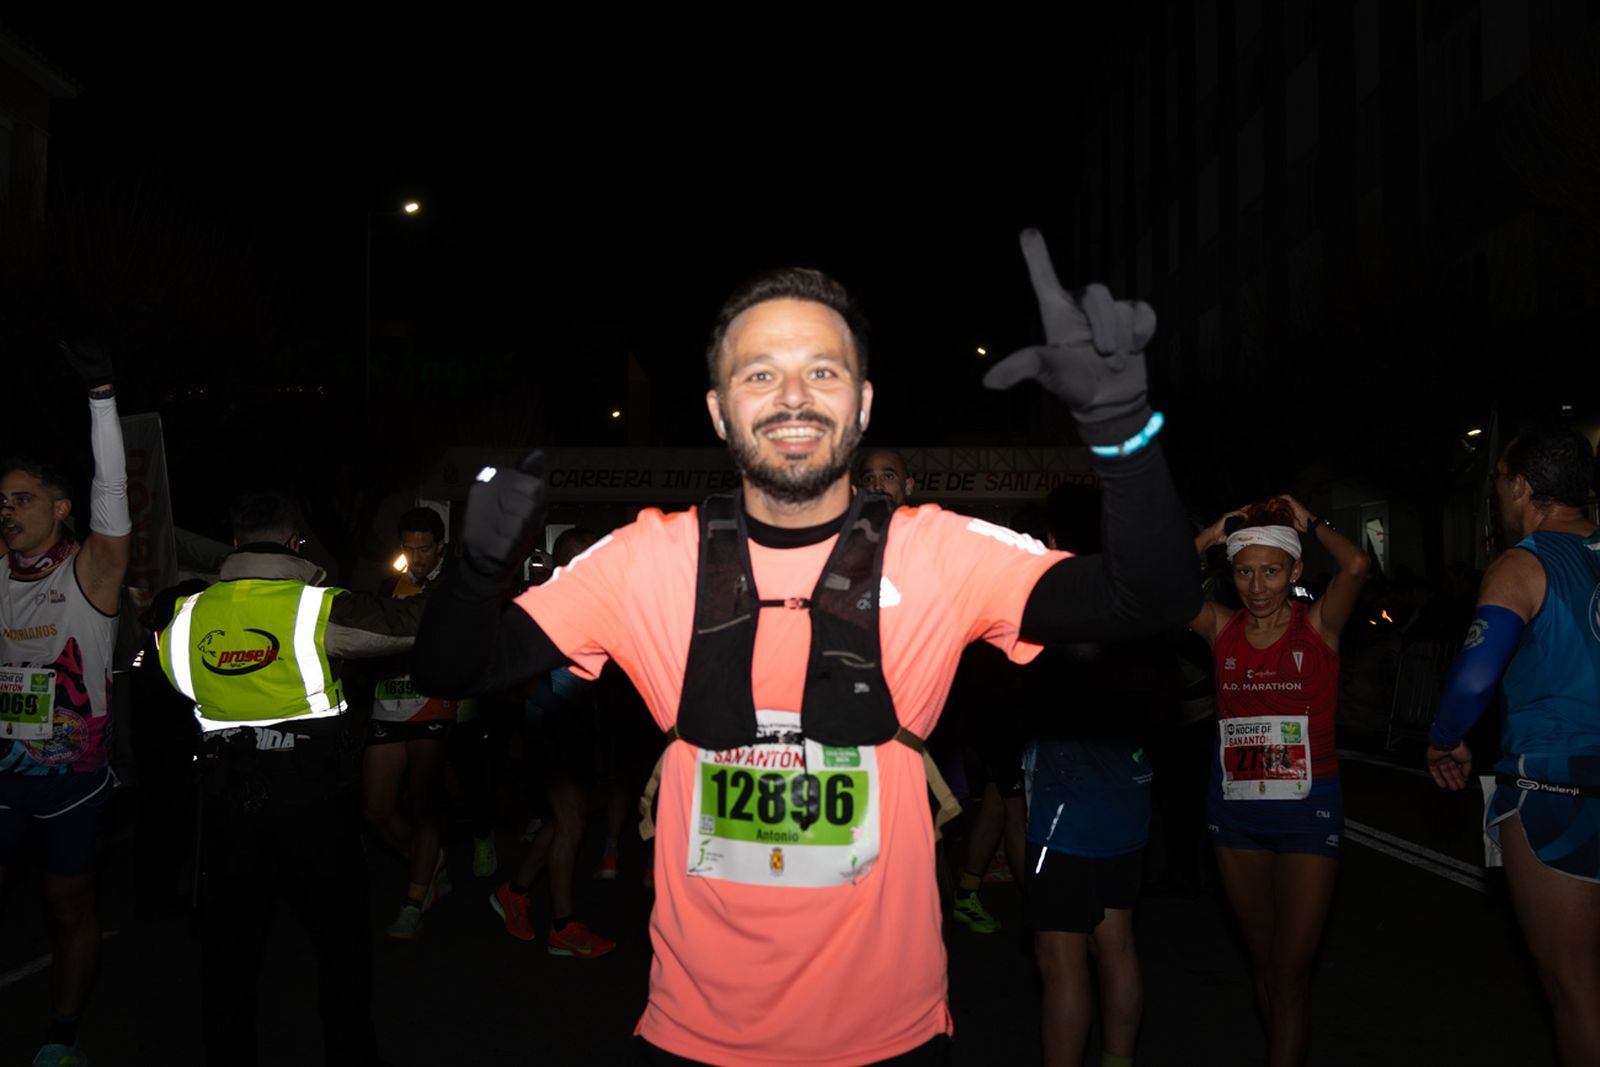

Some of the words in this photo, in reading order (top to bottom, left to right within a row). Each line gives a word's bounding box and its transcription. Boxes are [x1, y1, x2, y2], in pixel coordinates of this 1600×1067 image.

[549, 469, 652, 489] CARRERA
[661, 469, 744, 489] INTER
[945, 472, 977, 491] DE
[984, 472, 1031, 491] SAN
[1222, 682, 1239, 691] A.D.
[1242, 682, 1302, 692] MARATHON
[1235, 725, 1260, 735] NOCHE
[1229, 736, 1243, 746] SAN
[744, 746, 806, 769] ANTÓN
[1541, 784, 1580, 795] Kalenji
[711, 769, 856, 826] 12896
[756, 828, 800, 843] Antonio
